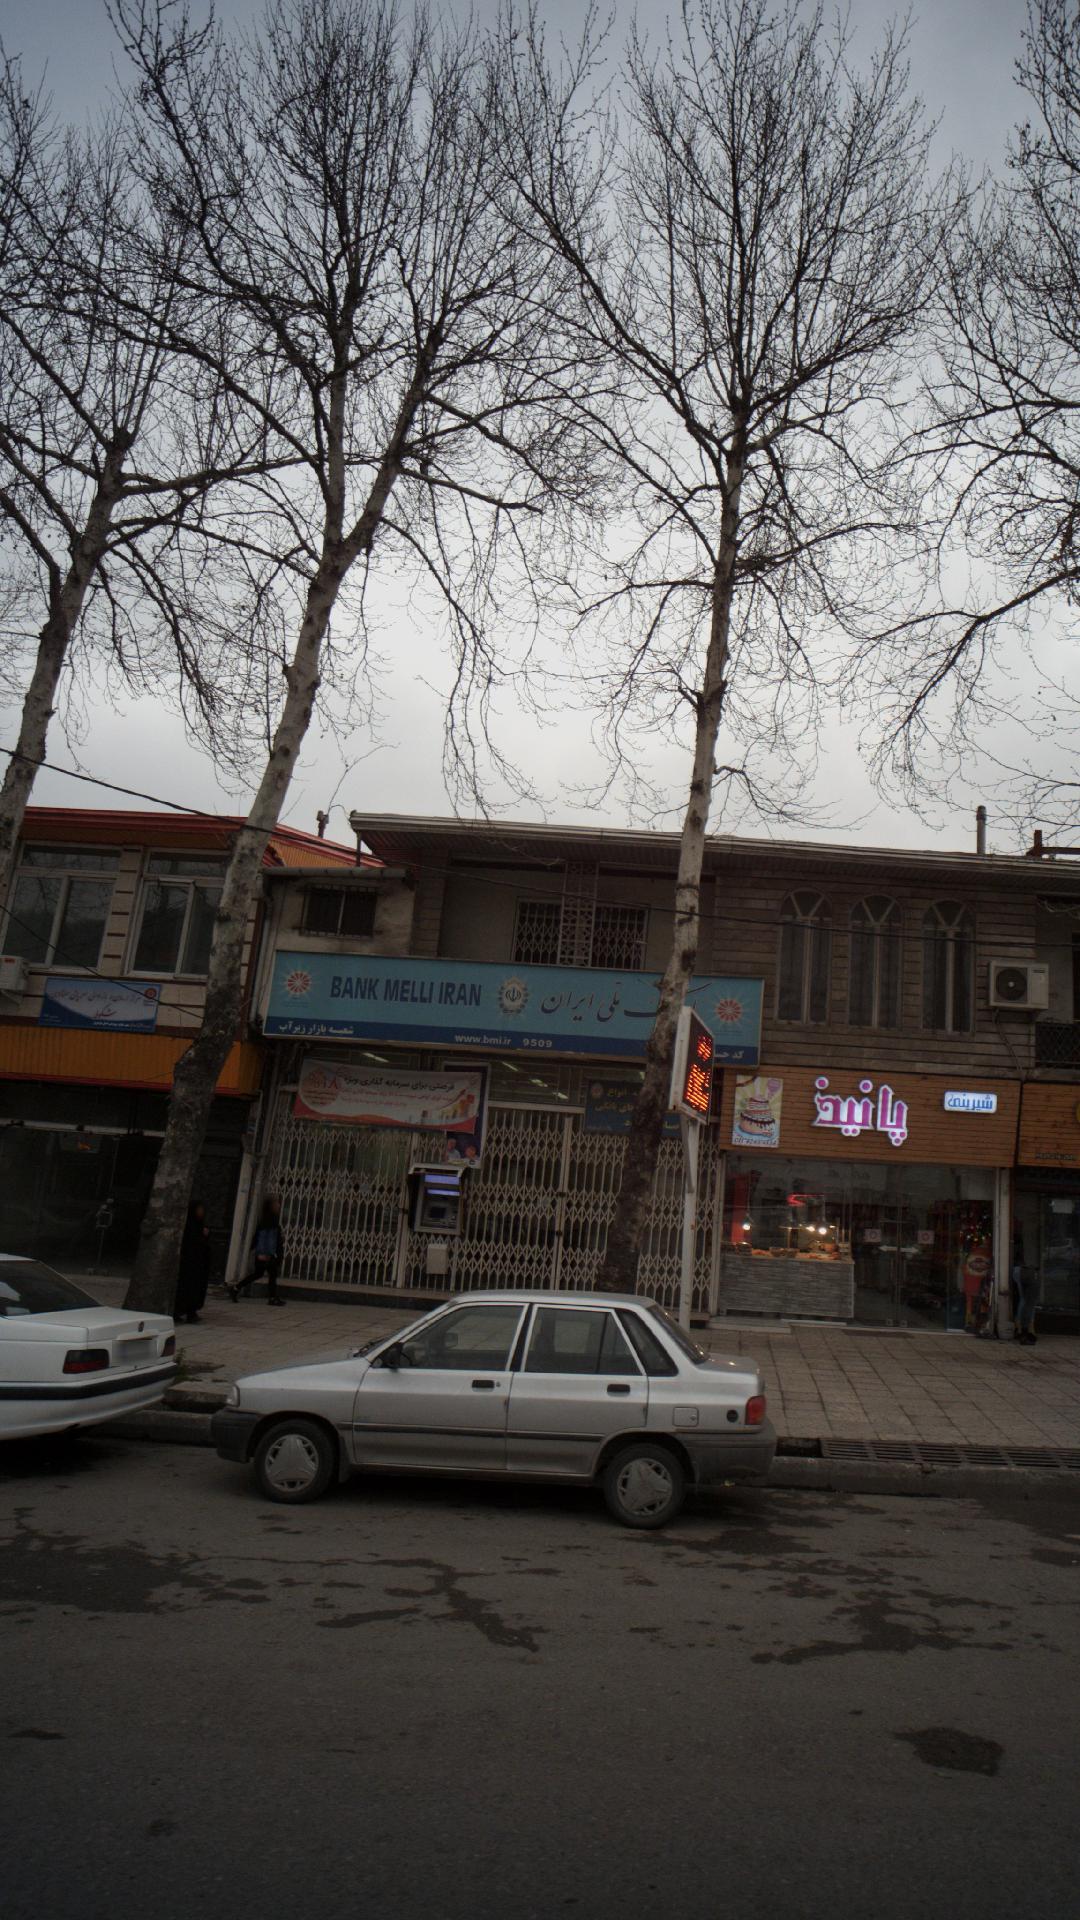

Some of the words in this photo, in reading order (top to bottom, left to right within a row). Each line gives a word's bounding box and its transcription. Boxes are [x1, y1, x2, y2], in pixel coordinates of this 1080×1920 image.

[330, 976, 379, 1001] BANK
[384, 978, 434, 1003] MELLI
[438, 981, 482, 1006] IRAN
[540, 991, 594, 1022] ایران
[306, 1023, 327, 1035] بازار
[328, 1026, 354, 1036] شعبه
[455, 1034, 511, 1045] www.bmi.ir
[947, 1093, 993, 1111] شیرینی
